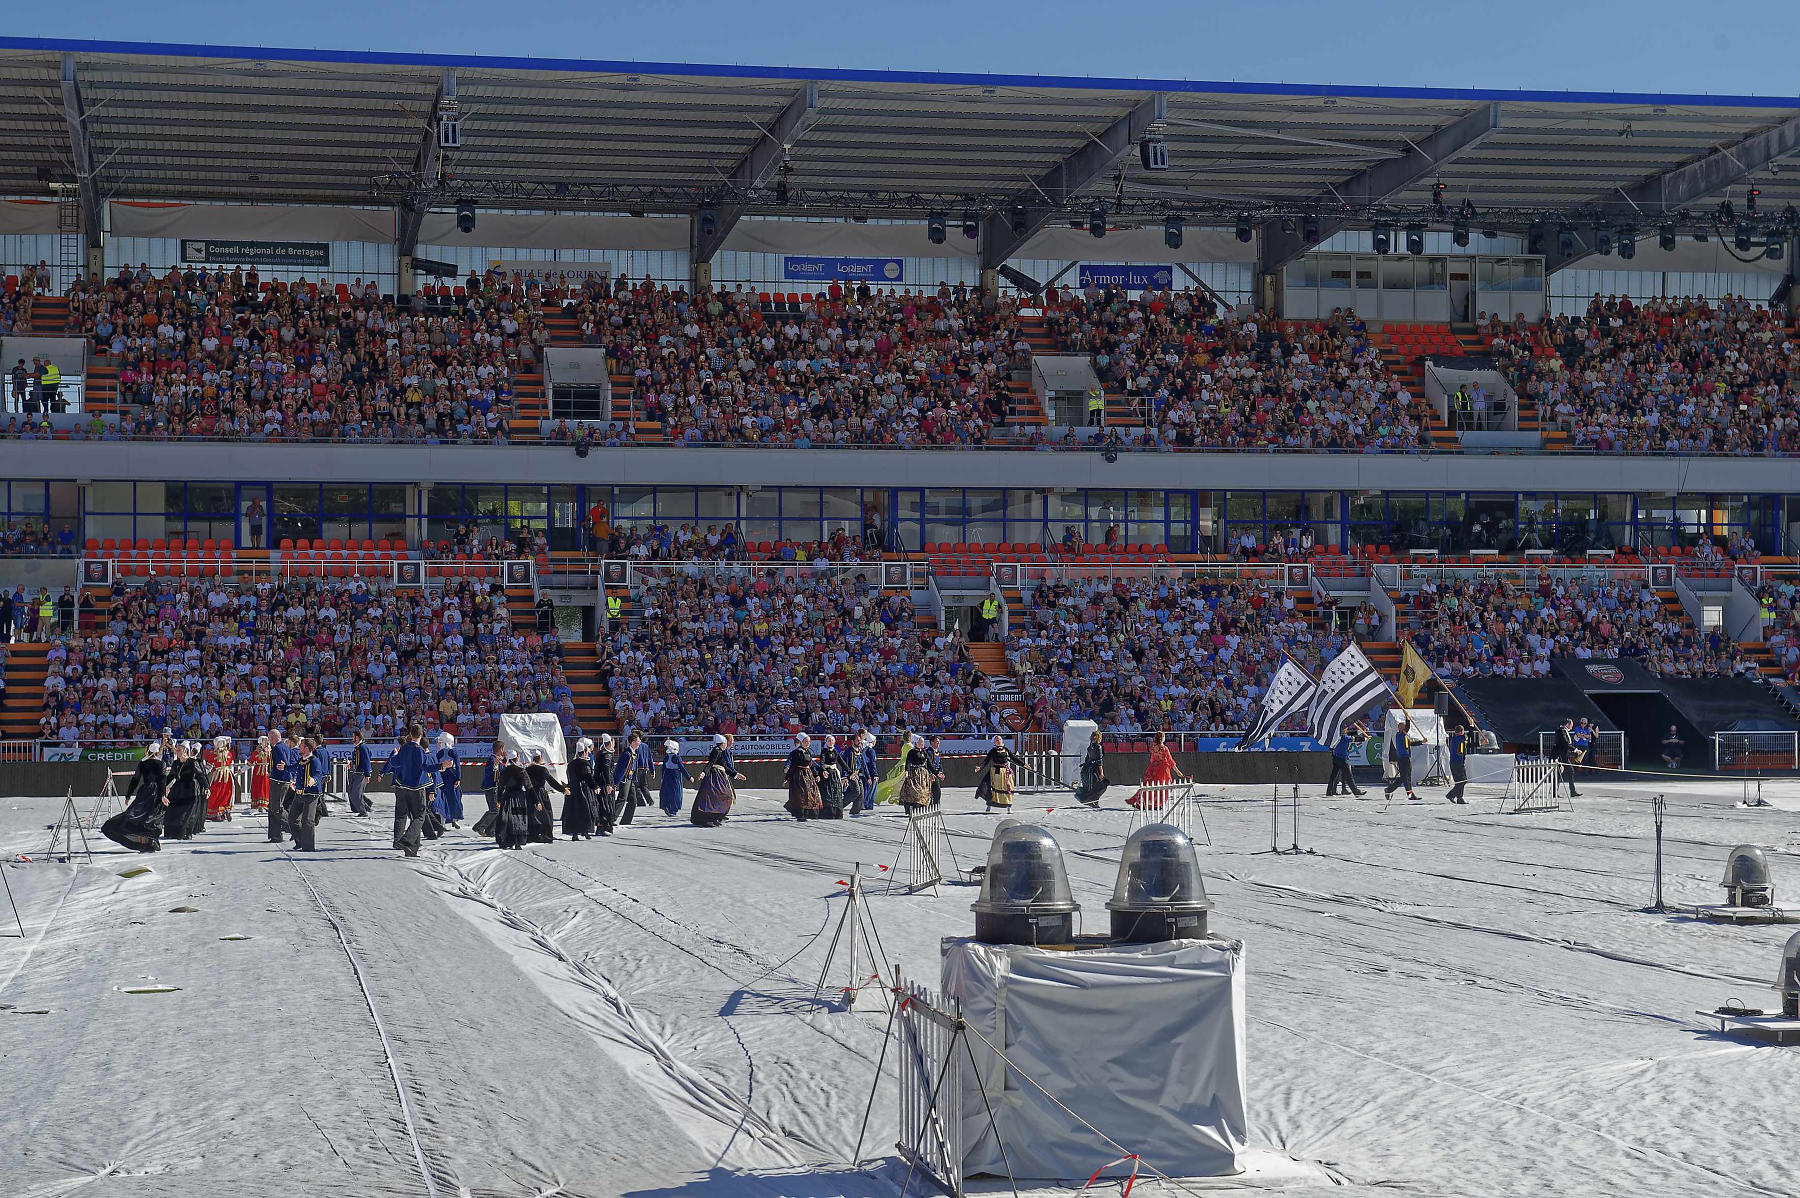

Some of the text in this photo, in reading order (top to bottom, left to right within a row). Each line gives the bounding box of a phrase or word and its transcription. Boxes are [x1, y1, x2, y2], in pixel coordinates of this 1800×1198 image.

[209, 245, 324, 257] Conseil régional de Bretagne
[511, 268, 543, 278] VILLE
[560, 269, 610, 279] LORIENT
[740, 743, 791, 751] AUTOMOBILES
[87, 752, 135, 761] CRÉDIT
